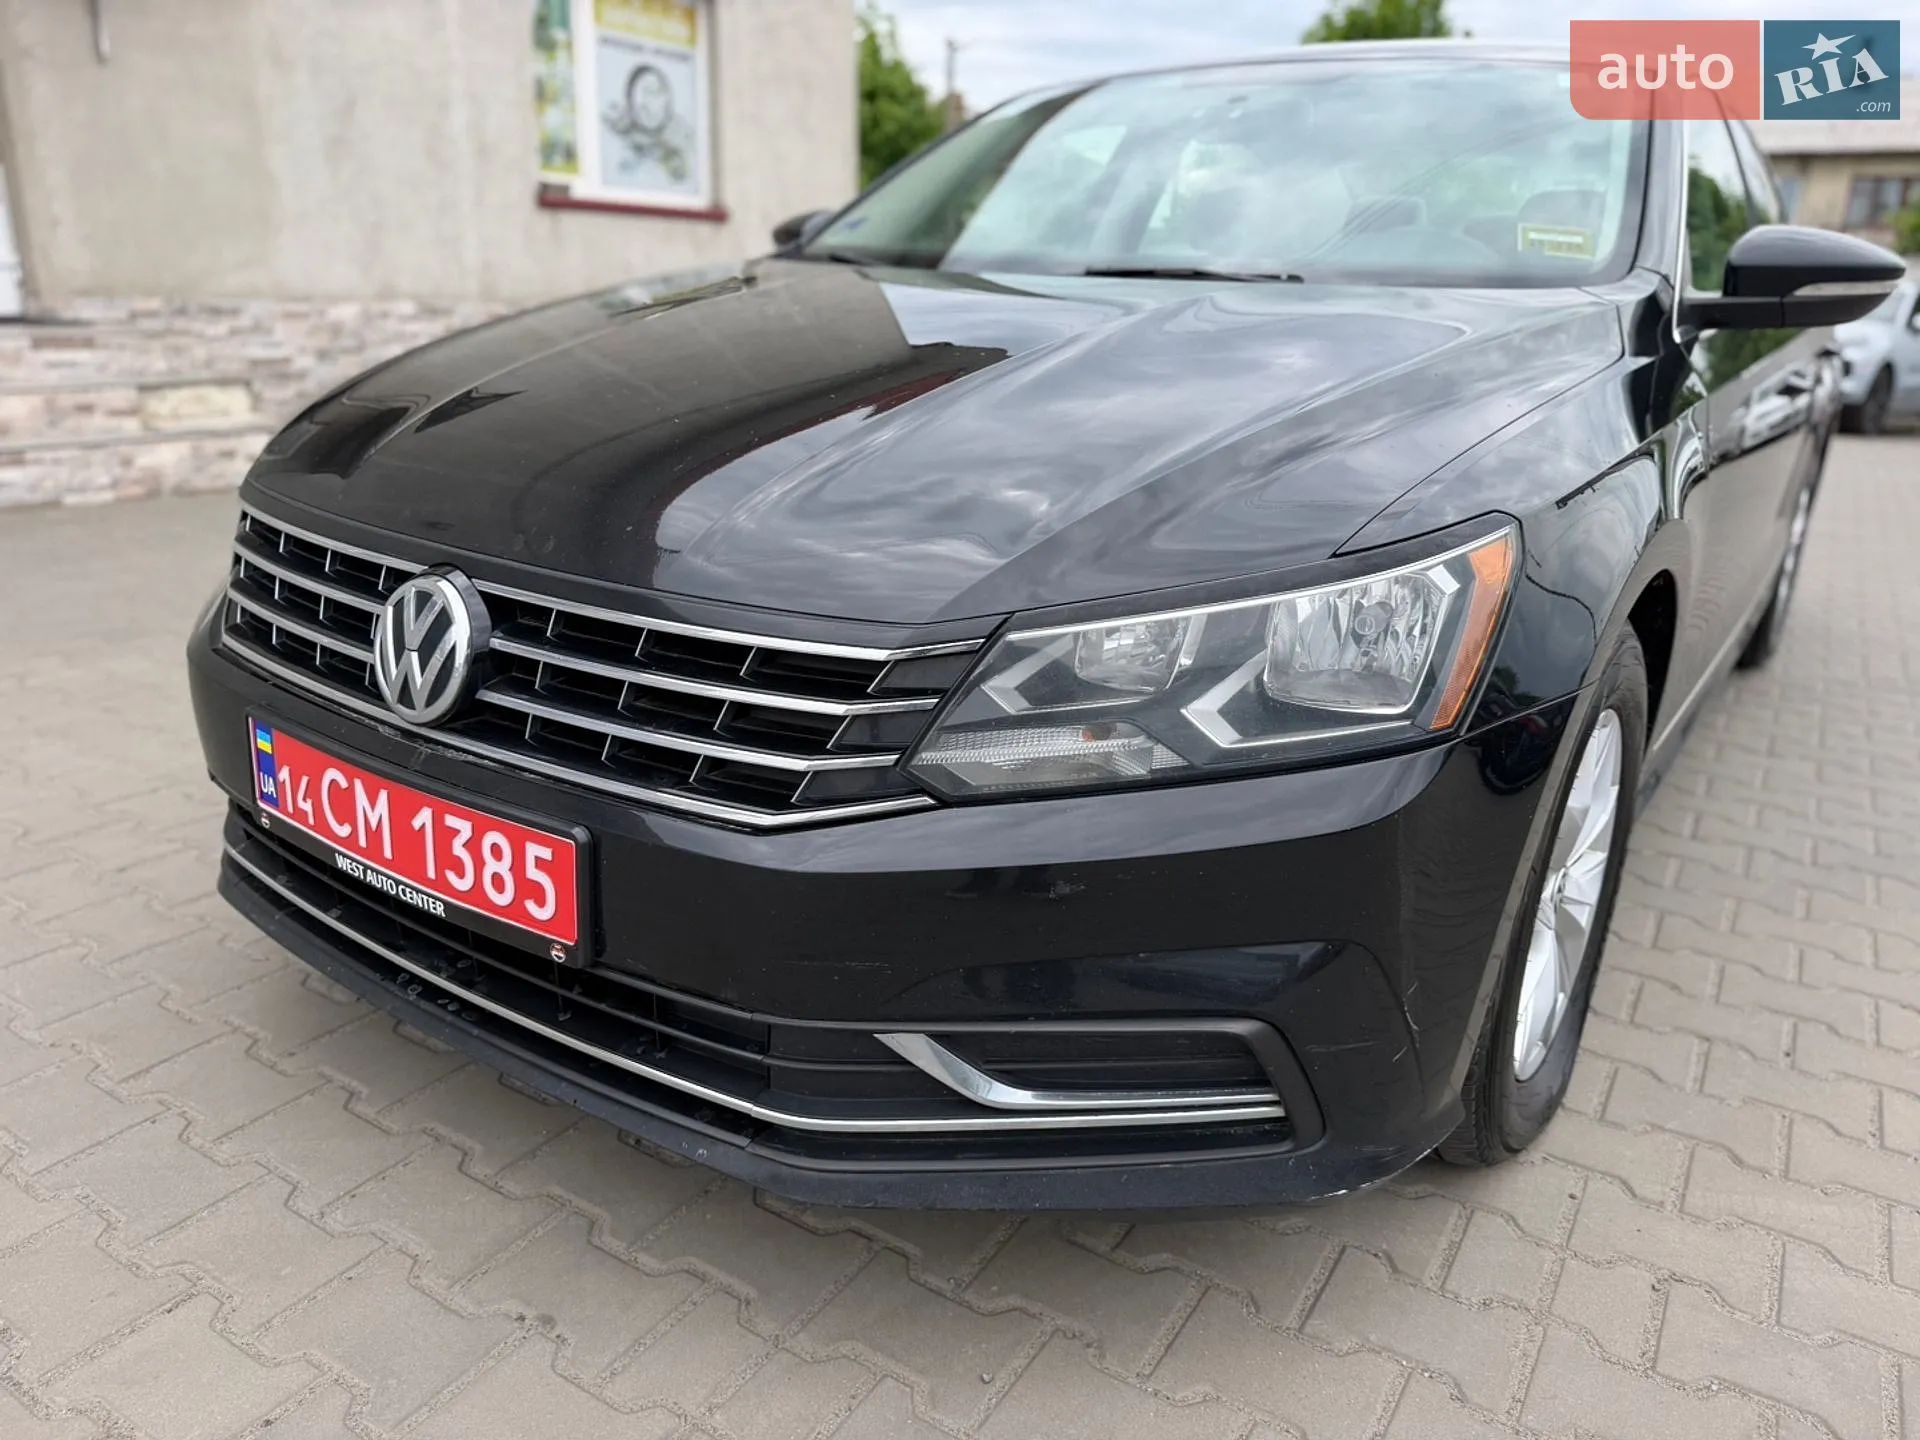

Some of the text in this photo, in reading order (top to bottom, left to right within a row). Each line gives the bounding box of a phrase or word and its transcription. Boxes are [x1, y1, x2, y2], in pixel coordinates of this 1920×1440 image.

[259, 770, 277, 799] UA
[335, 852, 446, 917] WEST AUTO CENTER
[411, 806, 557, 921] 1385
